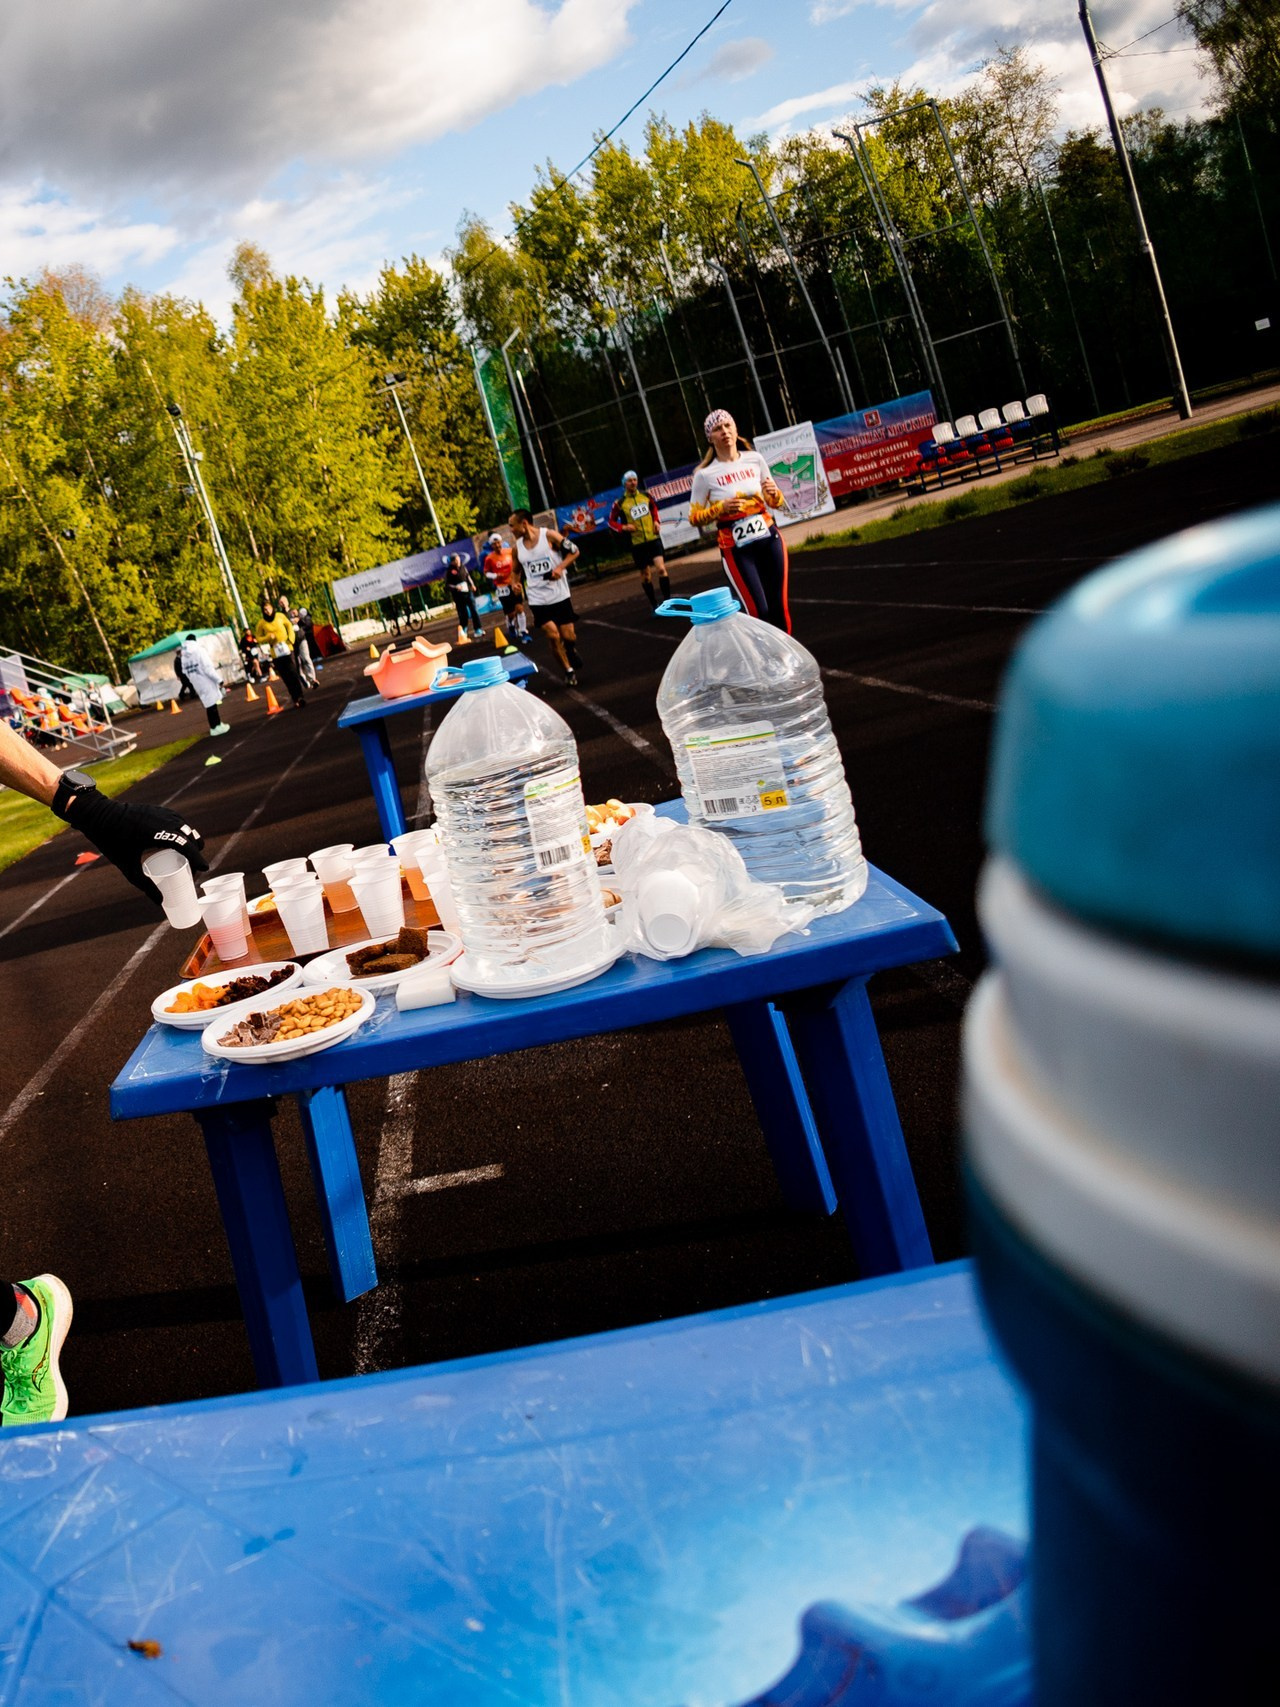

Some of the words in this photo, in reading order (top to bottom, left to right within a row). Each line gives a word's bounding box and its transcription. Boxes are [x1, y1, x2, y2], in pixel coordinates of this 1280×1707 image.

[734, 519, 766, 541] 242
[531, 561, 550, 573] 279
[764, 796, 773, 806] 5
